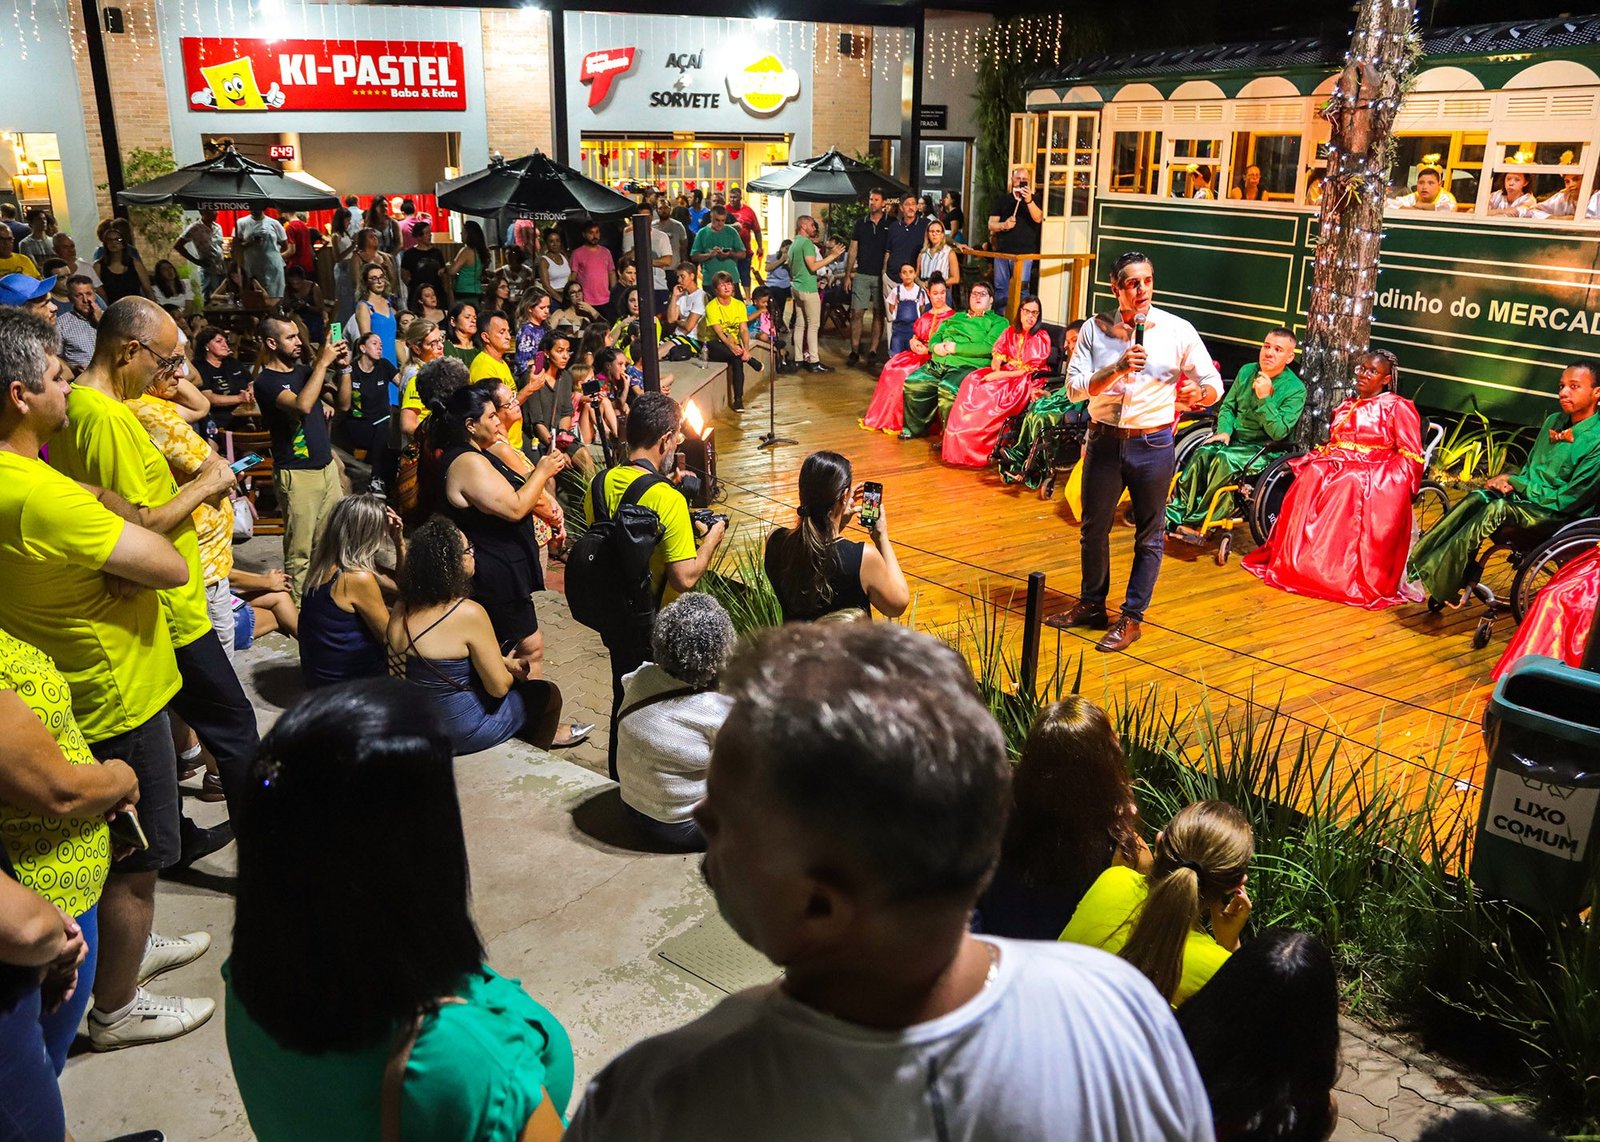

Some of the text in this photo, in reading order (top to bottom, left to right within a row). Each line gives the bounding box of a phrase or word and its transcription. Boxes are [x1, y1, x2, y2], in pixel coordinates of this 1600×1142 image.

[278, 53, 457, 87] KI-PASTEL
[665, 47, 704, 74] AÇAÍ
[390, 87, 458, 99] Baba & Edna
[649, 91, 721, 109] SORVETE
[270, 146, 293, 157] 649
[1449, 296, 1481, 319] do
[1513, 797, 1566, 826] LIXO
[1493, 814, 1579, 854] COMUM
